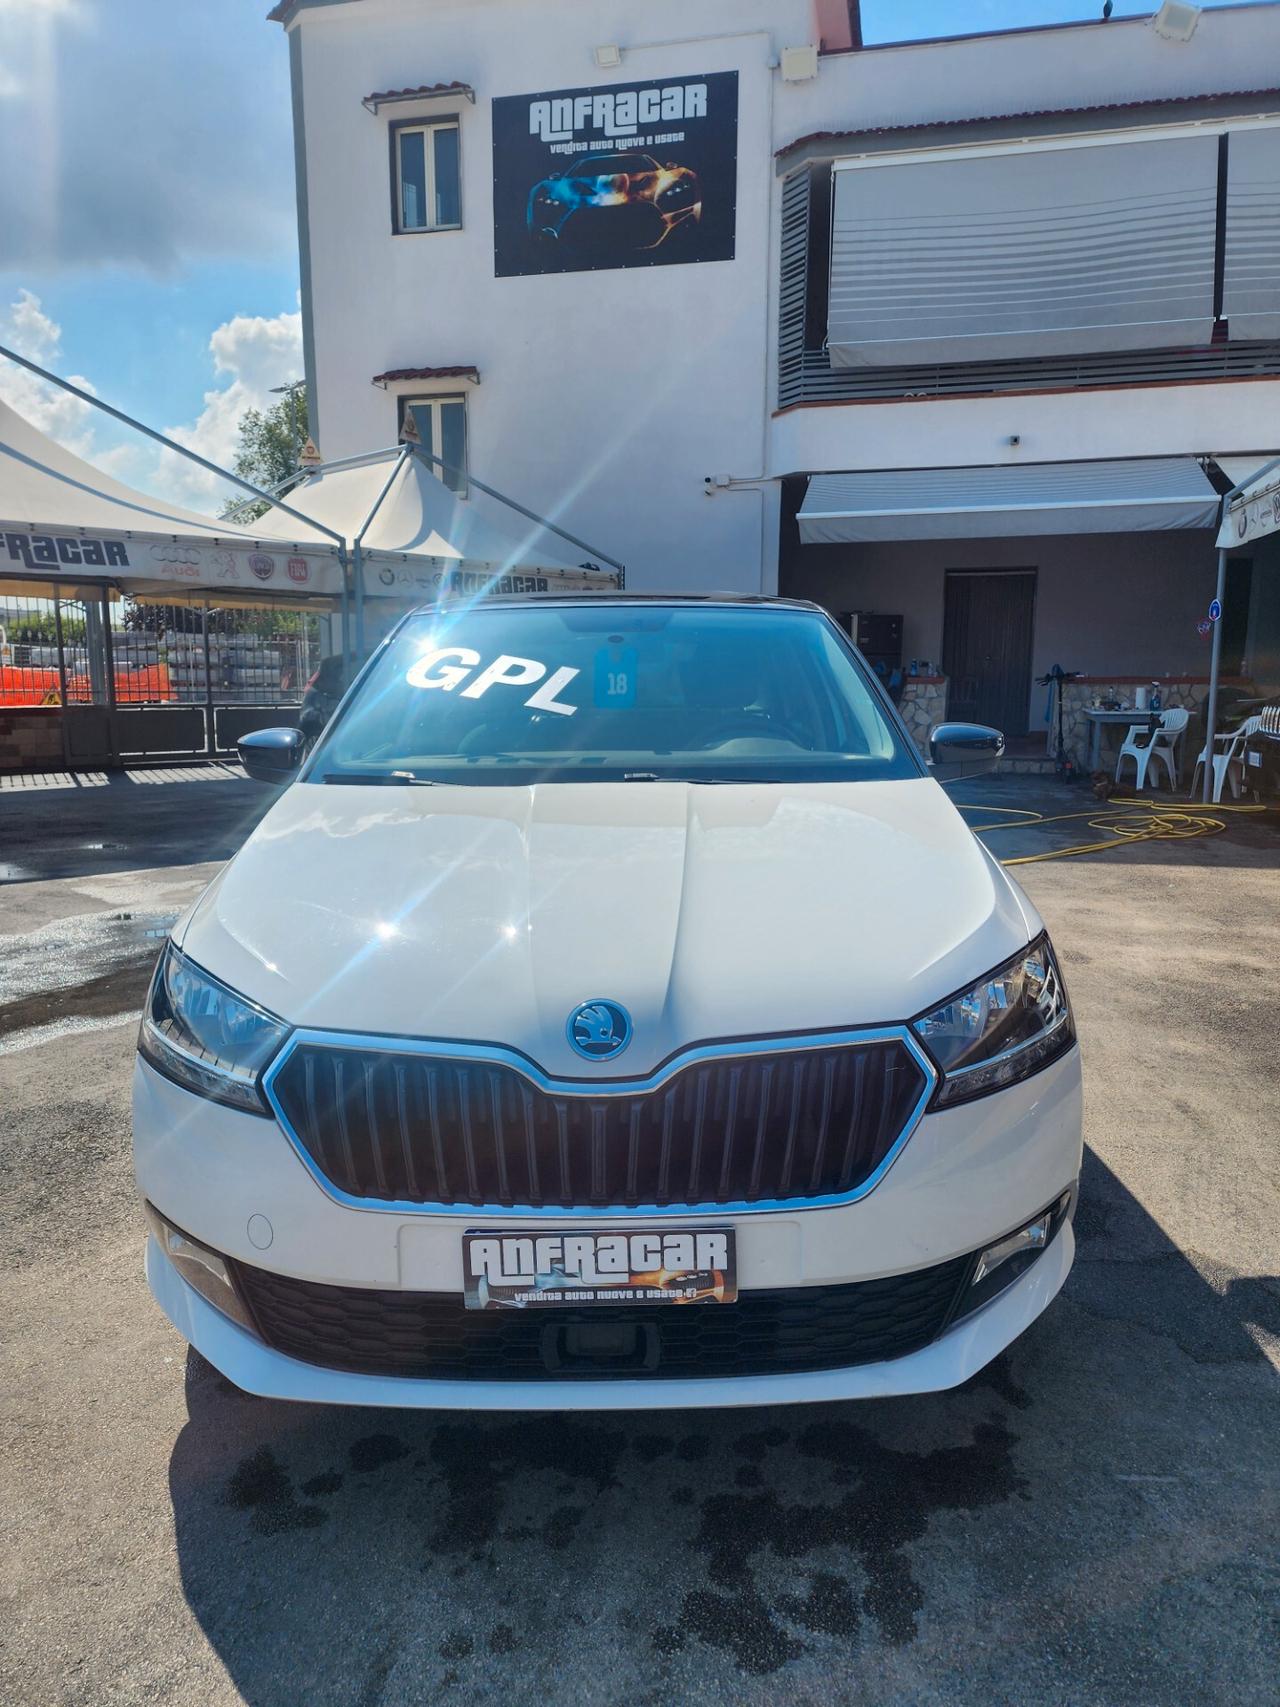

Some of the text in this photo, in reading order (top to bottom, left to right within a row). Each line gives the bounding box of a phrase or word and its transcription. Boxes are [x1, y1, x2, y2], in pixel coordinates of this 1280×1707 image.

[590, 140, 613, 151] auto
[0, 533, 130, 570] RACAR
[405, 647, 581, 717] GPL
[607, 672, 628, 695] 18
[514, 1290, 562, 1302] vendita
[564, 1290, 595, 1301] auto
[597, 1289, 634, 1300] nuove
